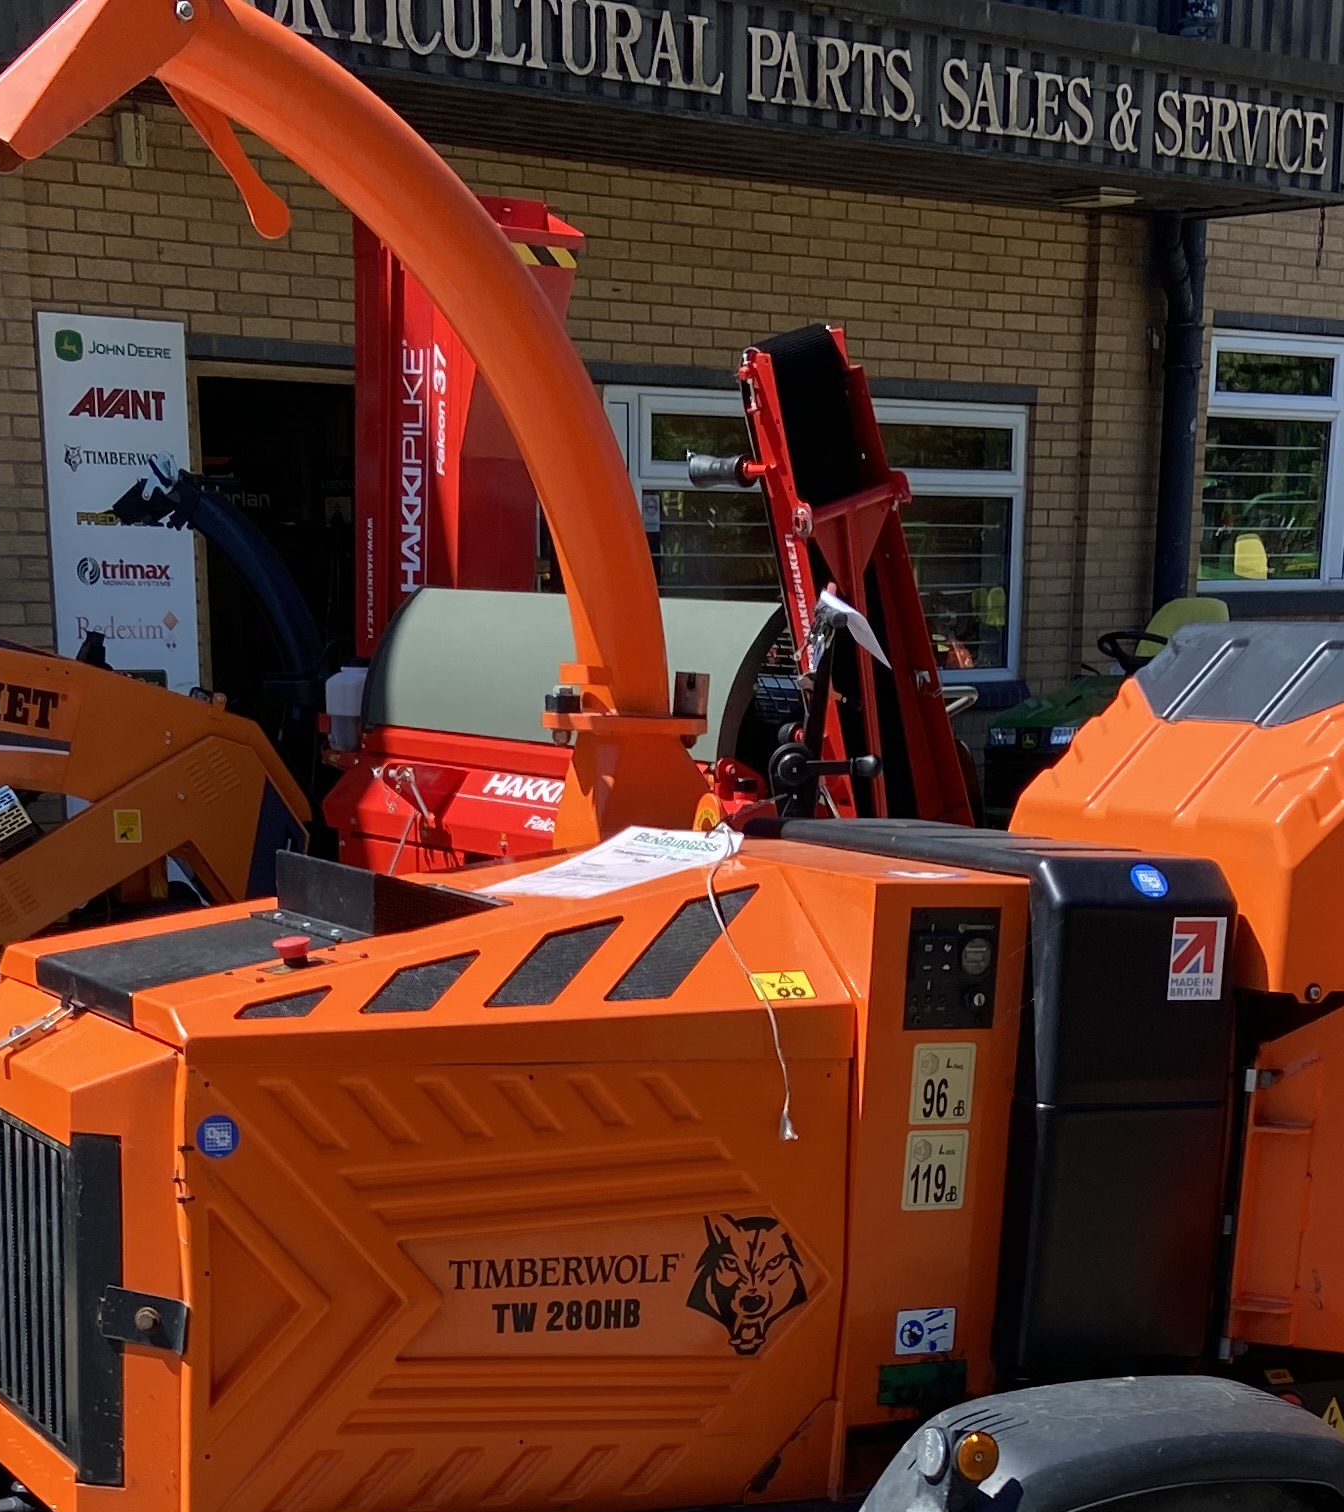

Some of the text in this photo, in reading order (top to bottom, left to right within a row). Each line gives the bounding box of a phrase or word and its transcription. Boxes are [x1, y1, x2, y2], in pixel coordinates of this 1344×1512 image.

[747, 26, 921, 128] PARTS,
[940, 58, 1094, 146] SALES
[1109, 83, 1142, 154] &
[1155, 89, 1330, 176] SERVICE
[88, 341, 172, 359] JOHN DEERE
[68, 387, 165, 421] AVANT
[433, 343, 447, 477] Falcon 37
[82, 450, 159, 465] TIMBERW
[401, 348, 423, 592] HAKKIPILKE
[101, 559, 171, 580] trimax
[1169, 988, 1214, 997] BRITAIN
[1170, 978, 1214, 987] MADE IN
[922, 1078, 949, 1118] 96
[910, 1164, 947, 1204] 119
[448, 1253, 680, 1290] TIMBERWOLF
[492, 1298, 641, 1334] TW 280HB
